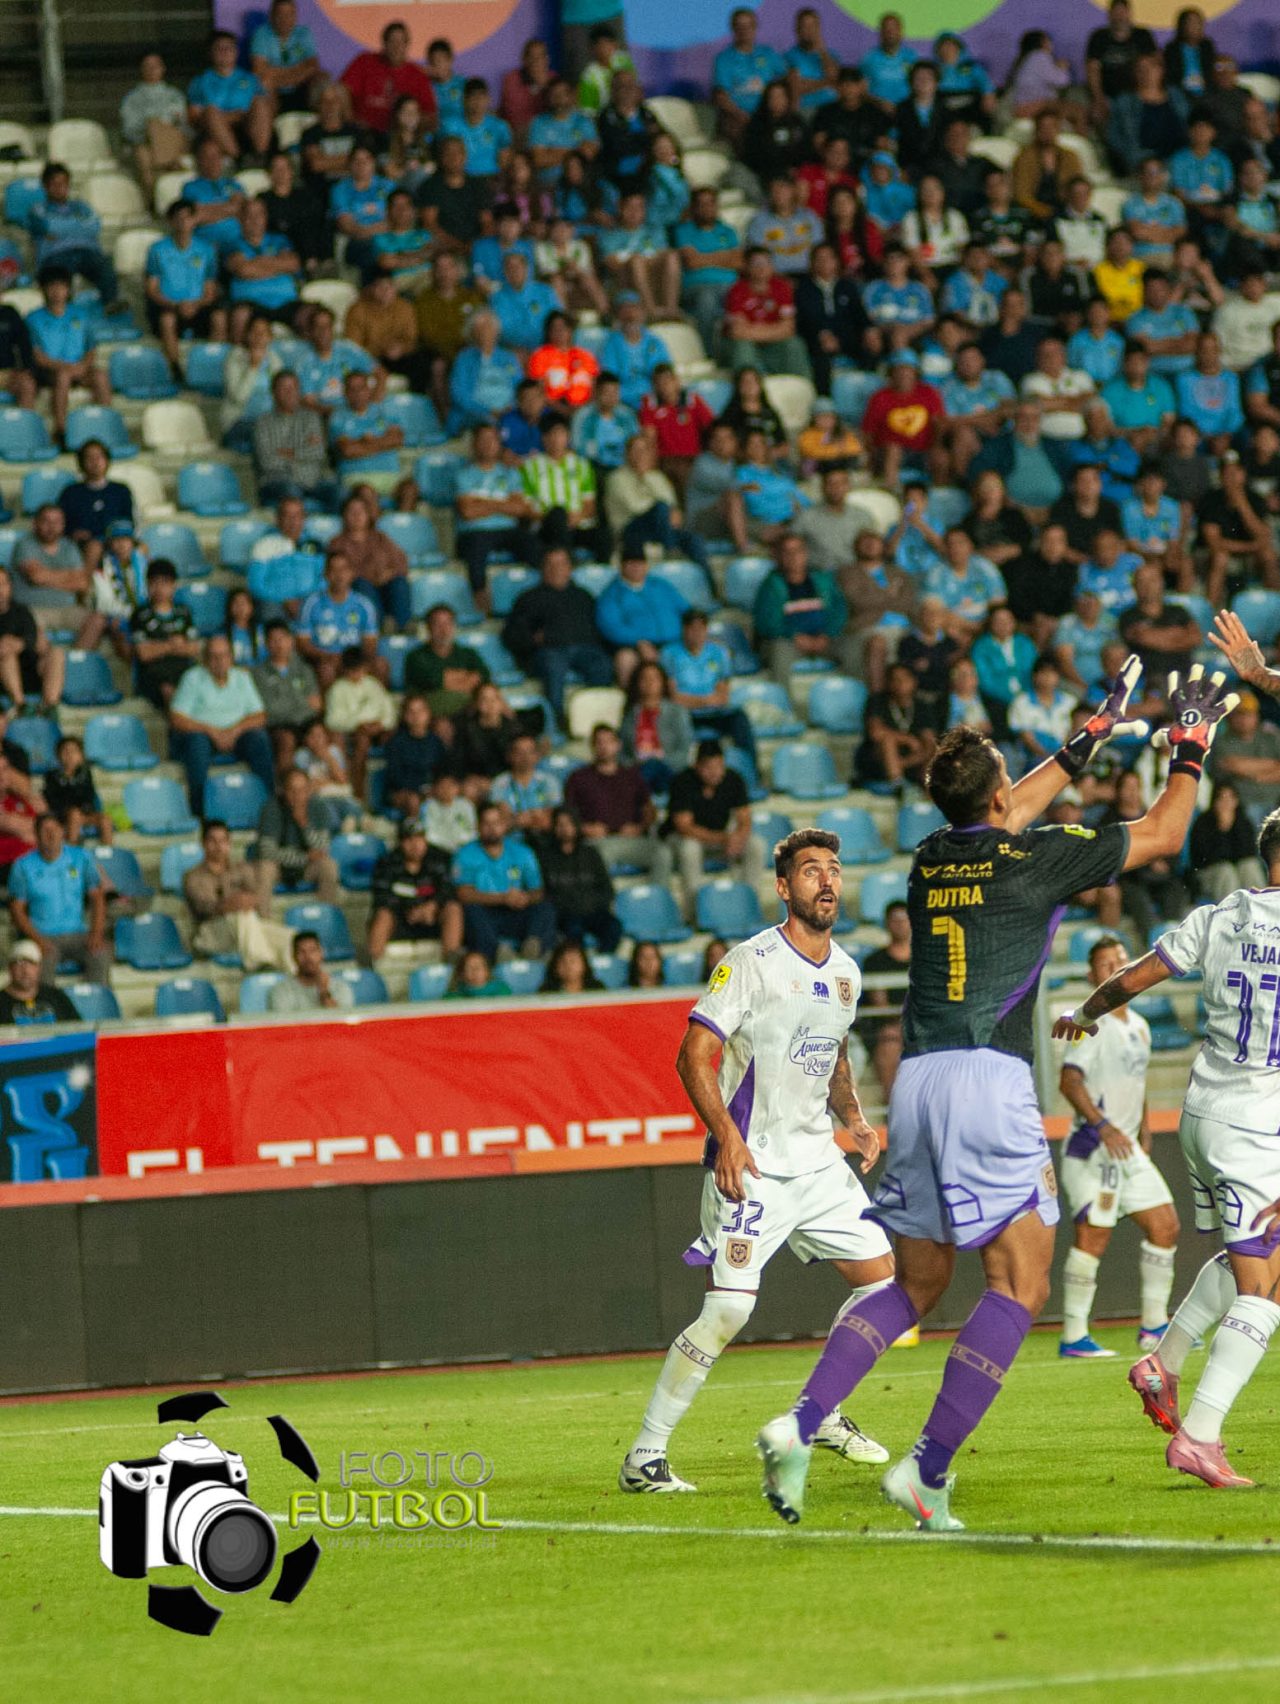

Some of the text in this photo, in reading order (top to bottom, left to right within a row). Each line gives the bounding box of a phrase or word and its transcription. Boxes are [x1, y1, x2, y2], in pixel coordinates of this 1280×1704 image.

[926, 885, 984, 909] DUTRA
[931, 916, 967, 1001] 1
[721, 1199, 765, 1237] 32
